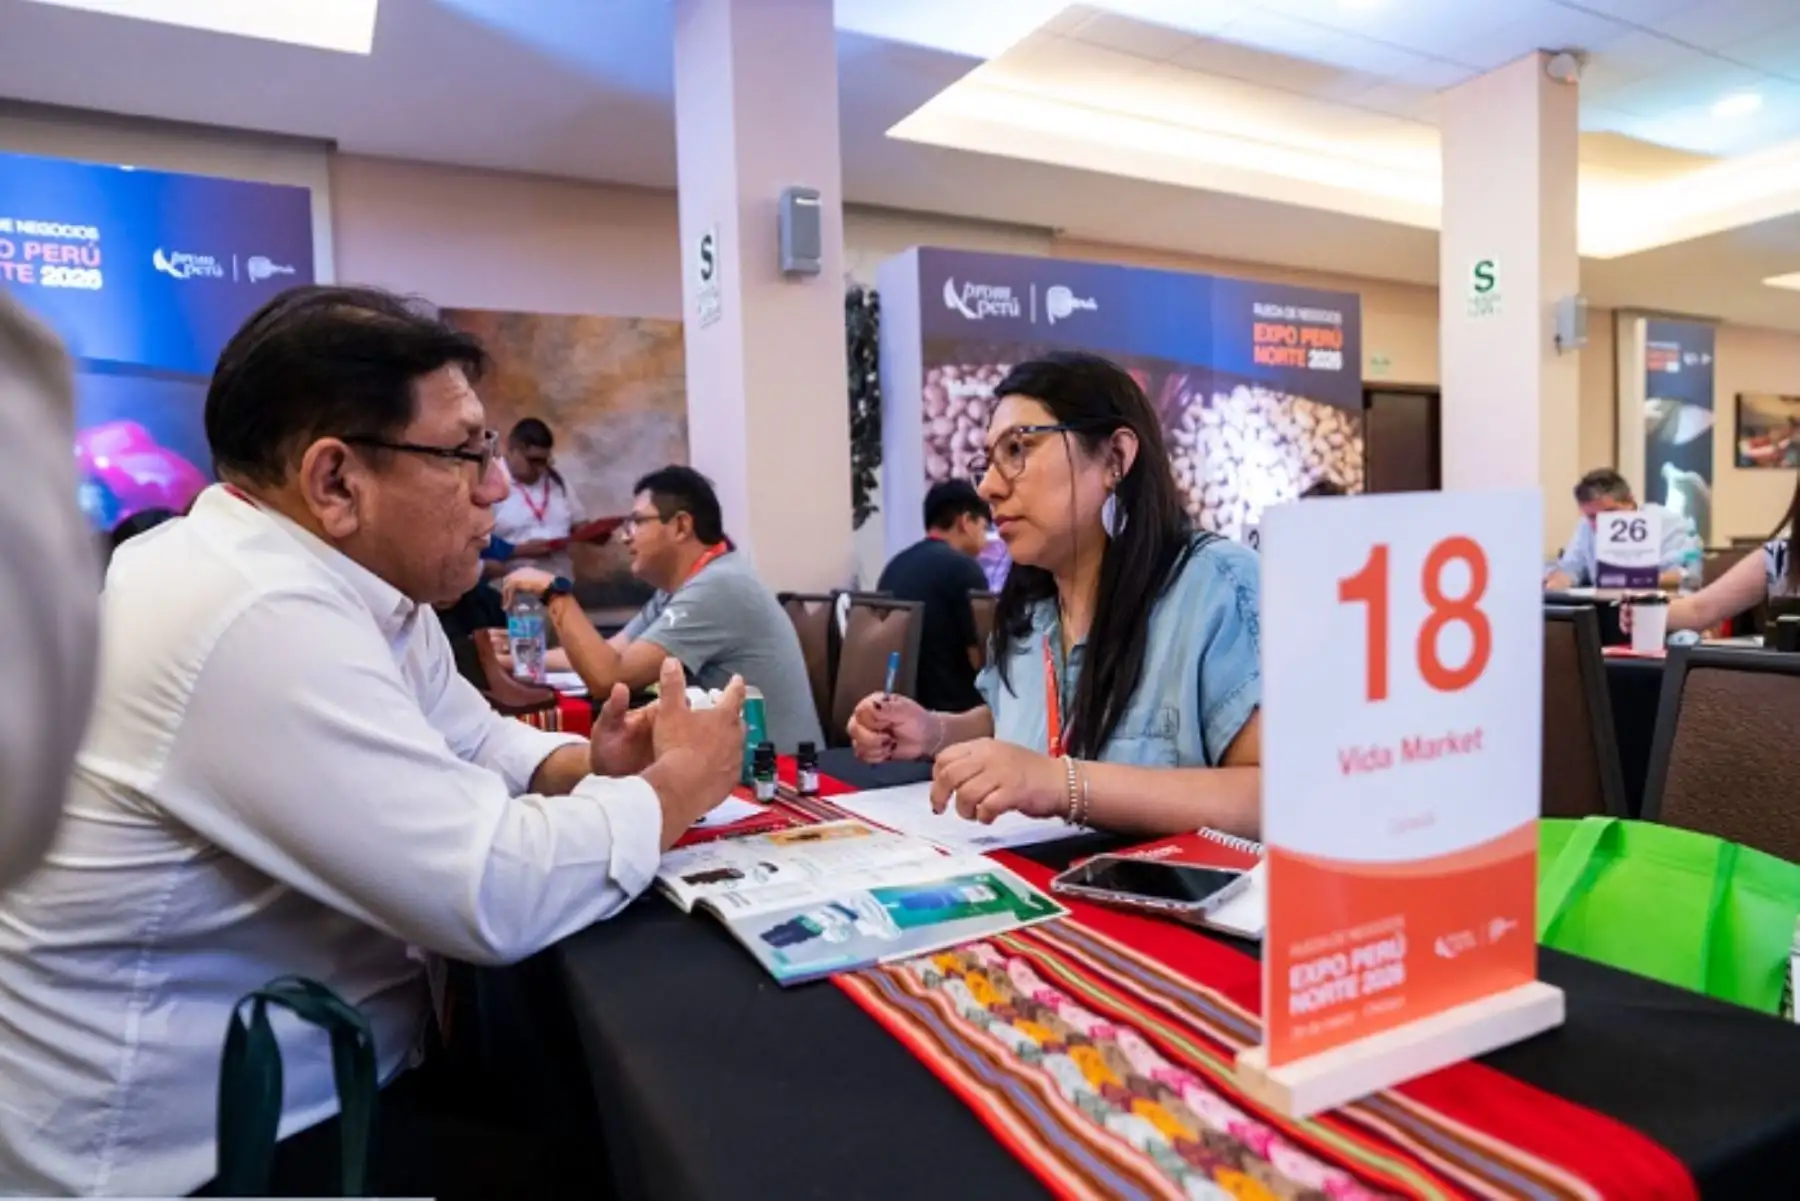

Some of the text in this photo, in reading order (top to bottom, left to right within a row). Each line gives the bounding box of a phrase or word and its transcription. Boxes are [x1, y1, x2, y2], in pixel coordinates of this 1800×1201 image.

[23, 240, 101, 268] PERÚ
[701, 233, 713, 282] S
[1474, 259, 1495, 293] S
[1253, 322, 1298, 346] EXPO
[1610, 518, 1648, 543] 26
[1337, 535, 1493, 702] 18
[1338, 726, 1484, 775] Vida Market
